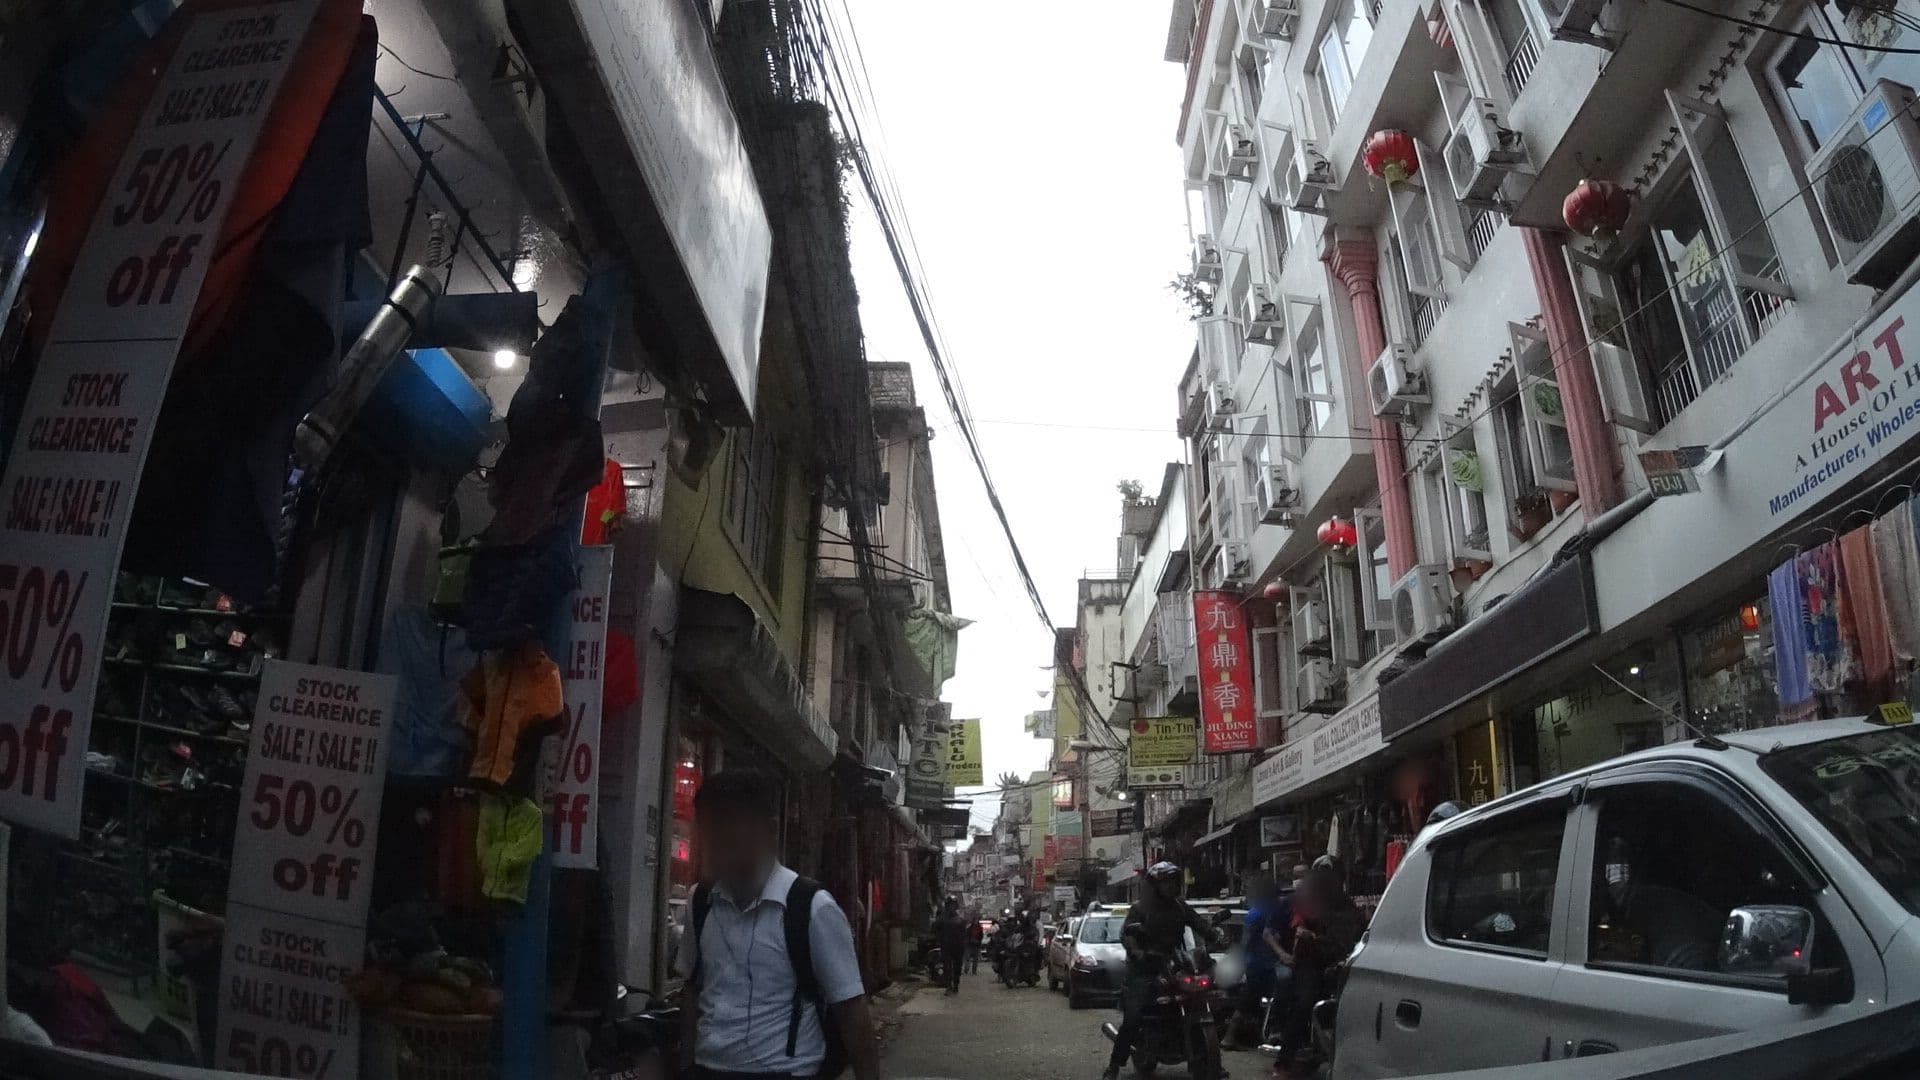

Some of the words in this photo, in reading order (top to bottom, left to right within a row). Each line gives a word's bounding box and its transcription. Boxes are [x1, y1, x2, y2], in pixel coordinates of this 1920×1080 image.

[217, 14, 282, 41] STOCK
[113, 138, 233, 227] 50%
[106, 233, 203, 308] off
[61, 372, 129, 407] STOCK
[1814, 315, 1905, 434] ART
[28, 416, 138, 454] CLEARENCE
[1794, 454, 1808, 473] A
[1811, 409, 1868, 460] House
[1873, 379, 1897, 413] Of
[1651, 474, 1683, 493] FUJI
[1769, 442, 1866, 516] Manufacturer,
[1207, 602, 1240, 710] 九鼎香
[296, 678, 360, 703] STOCK
[269, 694, 383, 728] CLEARENCE
[1207, 722, 1225, 733] JIU
[1226, 720, 1253, 732] DING
[1213, 730, 1249, 743] XIANG
[945, 762, 981, 771] Traders
[250, 773, 365, 849] 50%
[551, 793, 590, 855] ff
[273, 853, 361, 901] off
[260, 928, 327, 957] STOCK
